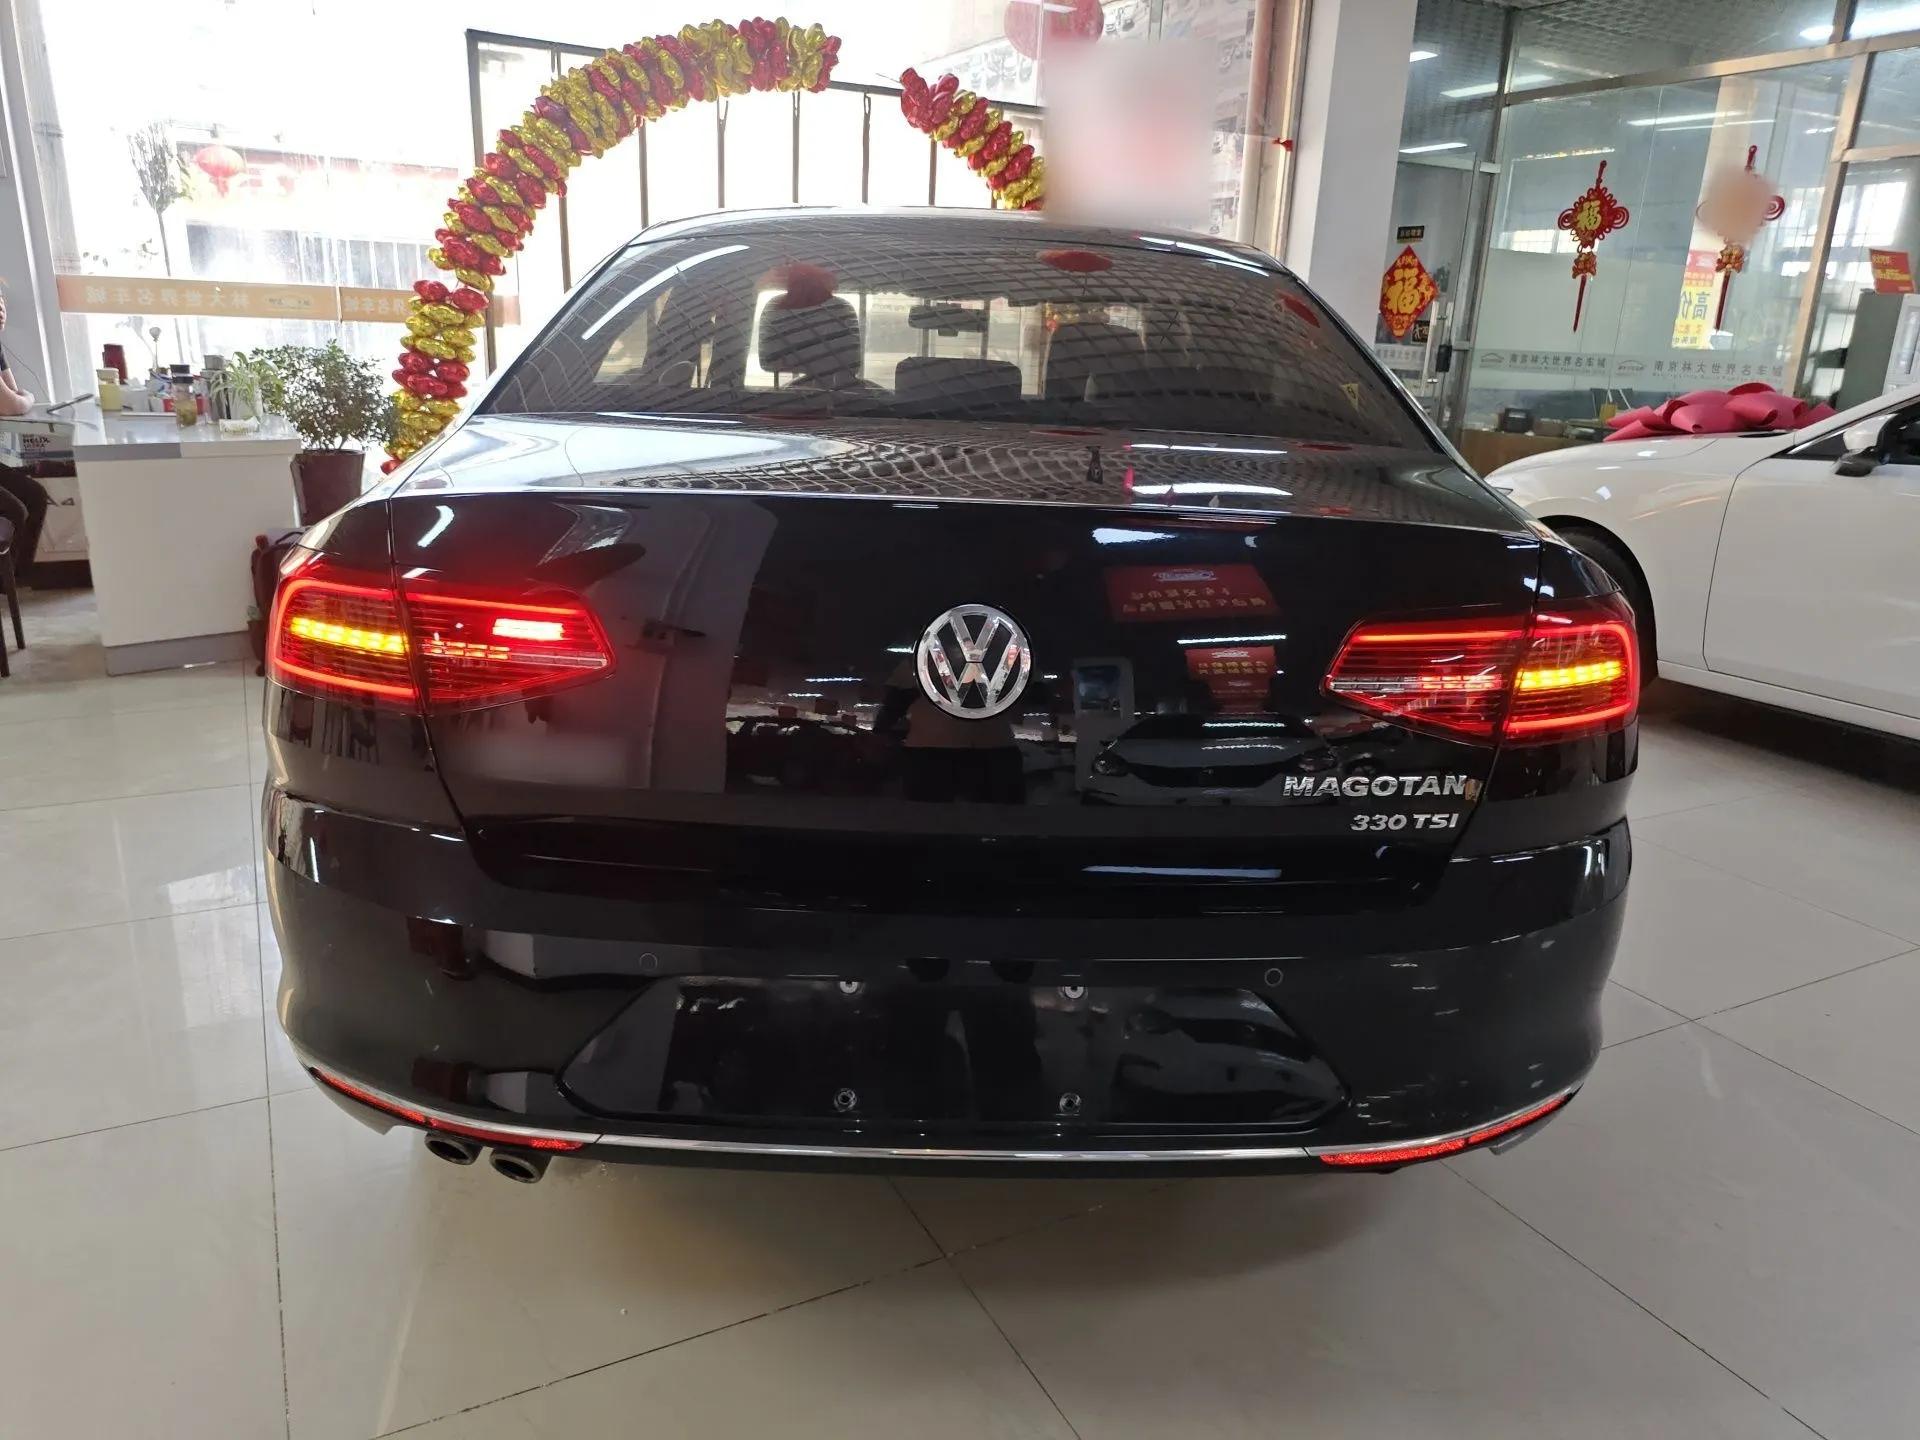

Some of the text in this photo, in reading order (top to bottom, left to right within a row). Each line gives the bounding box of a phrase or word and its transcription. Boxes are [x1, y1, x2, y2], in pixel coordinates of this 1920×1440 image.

[1577, 200, 1602, 231] 福
[1385, 268, 1421, 314] 福
[1283, 775, 1467, 797] MAGOTAN
[1351, 813, 1459, 831] 330 TSI
